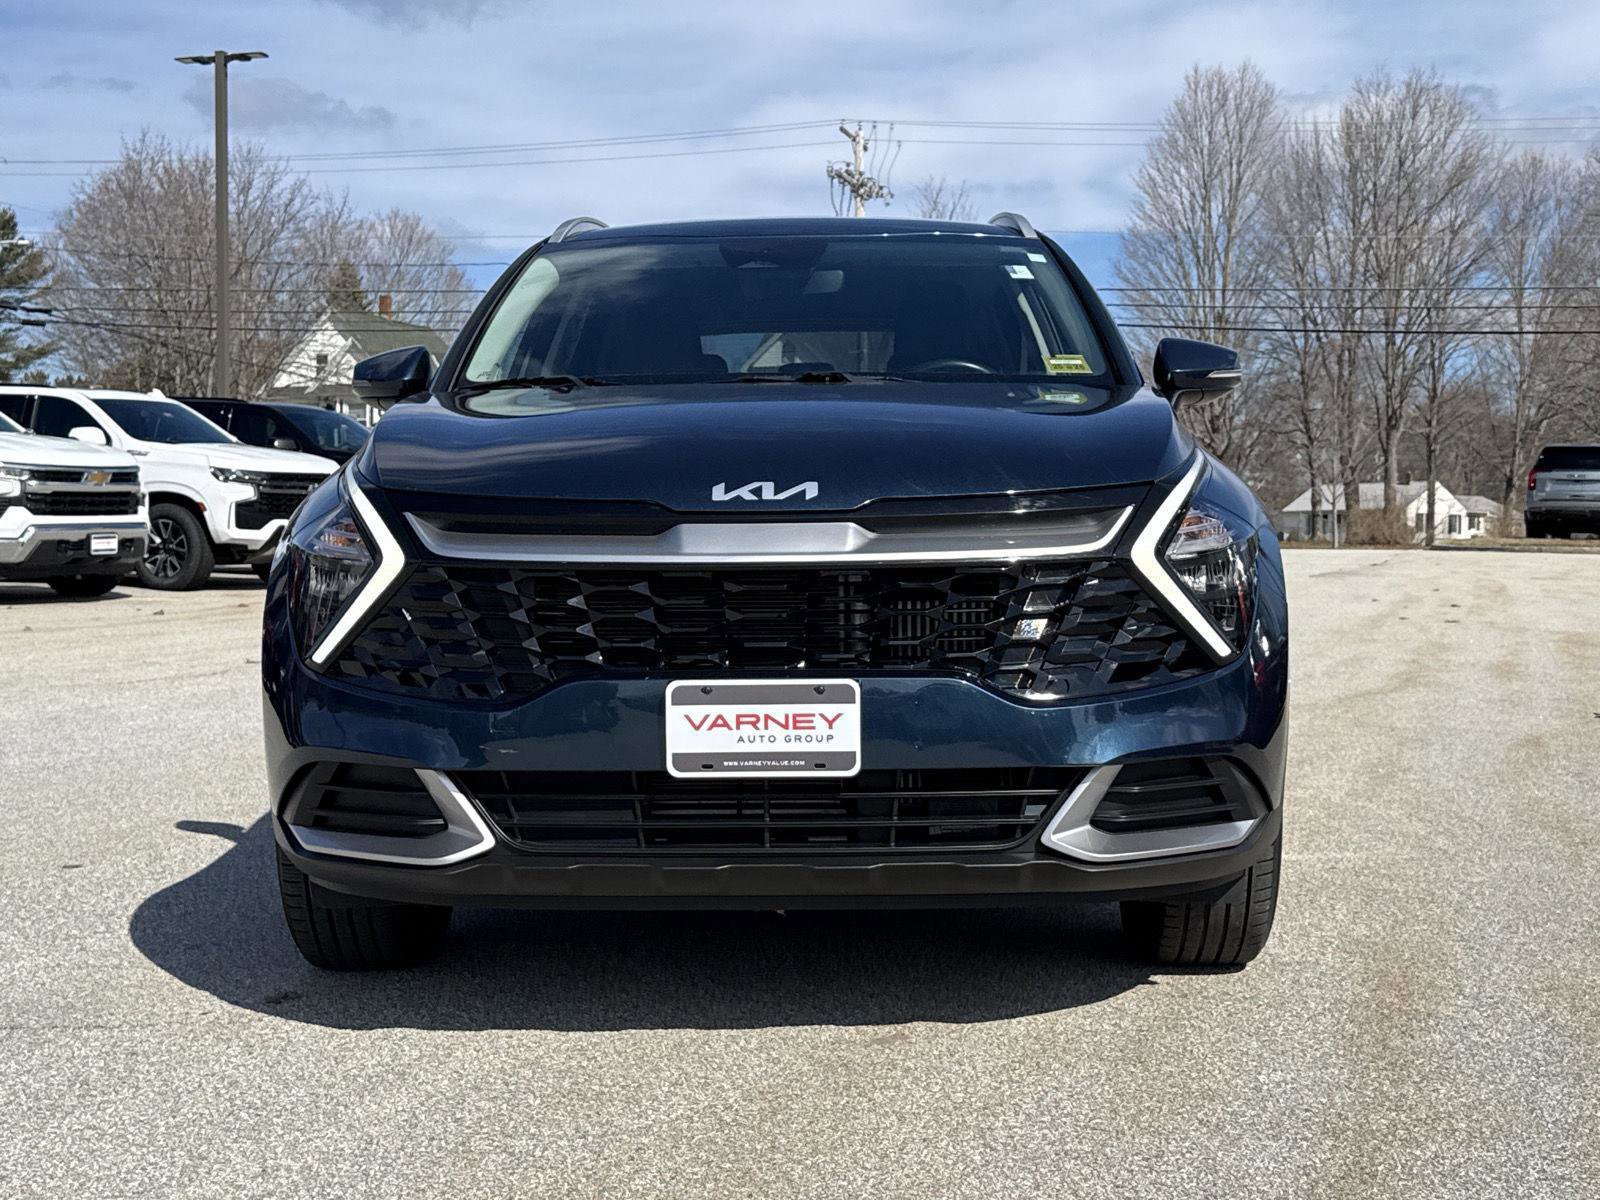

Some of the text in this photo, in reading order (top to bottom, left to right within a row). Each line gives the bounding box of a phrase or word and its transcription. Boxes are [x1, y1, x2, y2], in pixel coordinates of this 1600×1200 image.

[712, 481, 818, 501] KIA
[684, 713, 844, 731] VARNEY
[737, 734, 834, 743] AUTO GROUP
